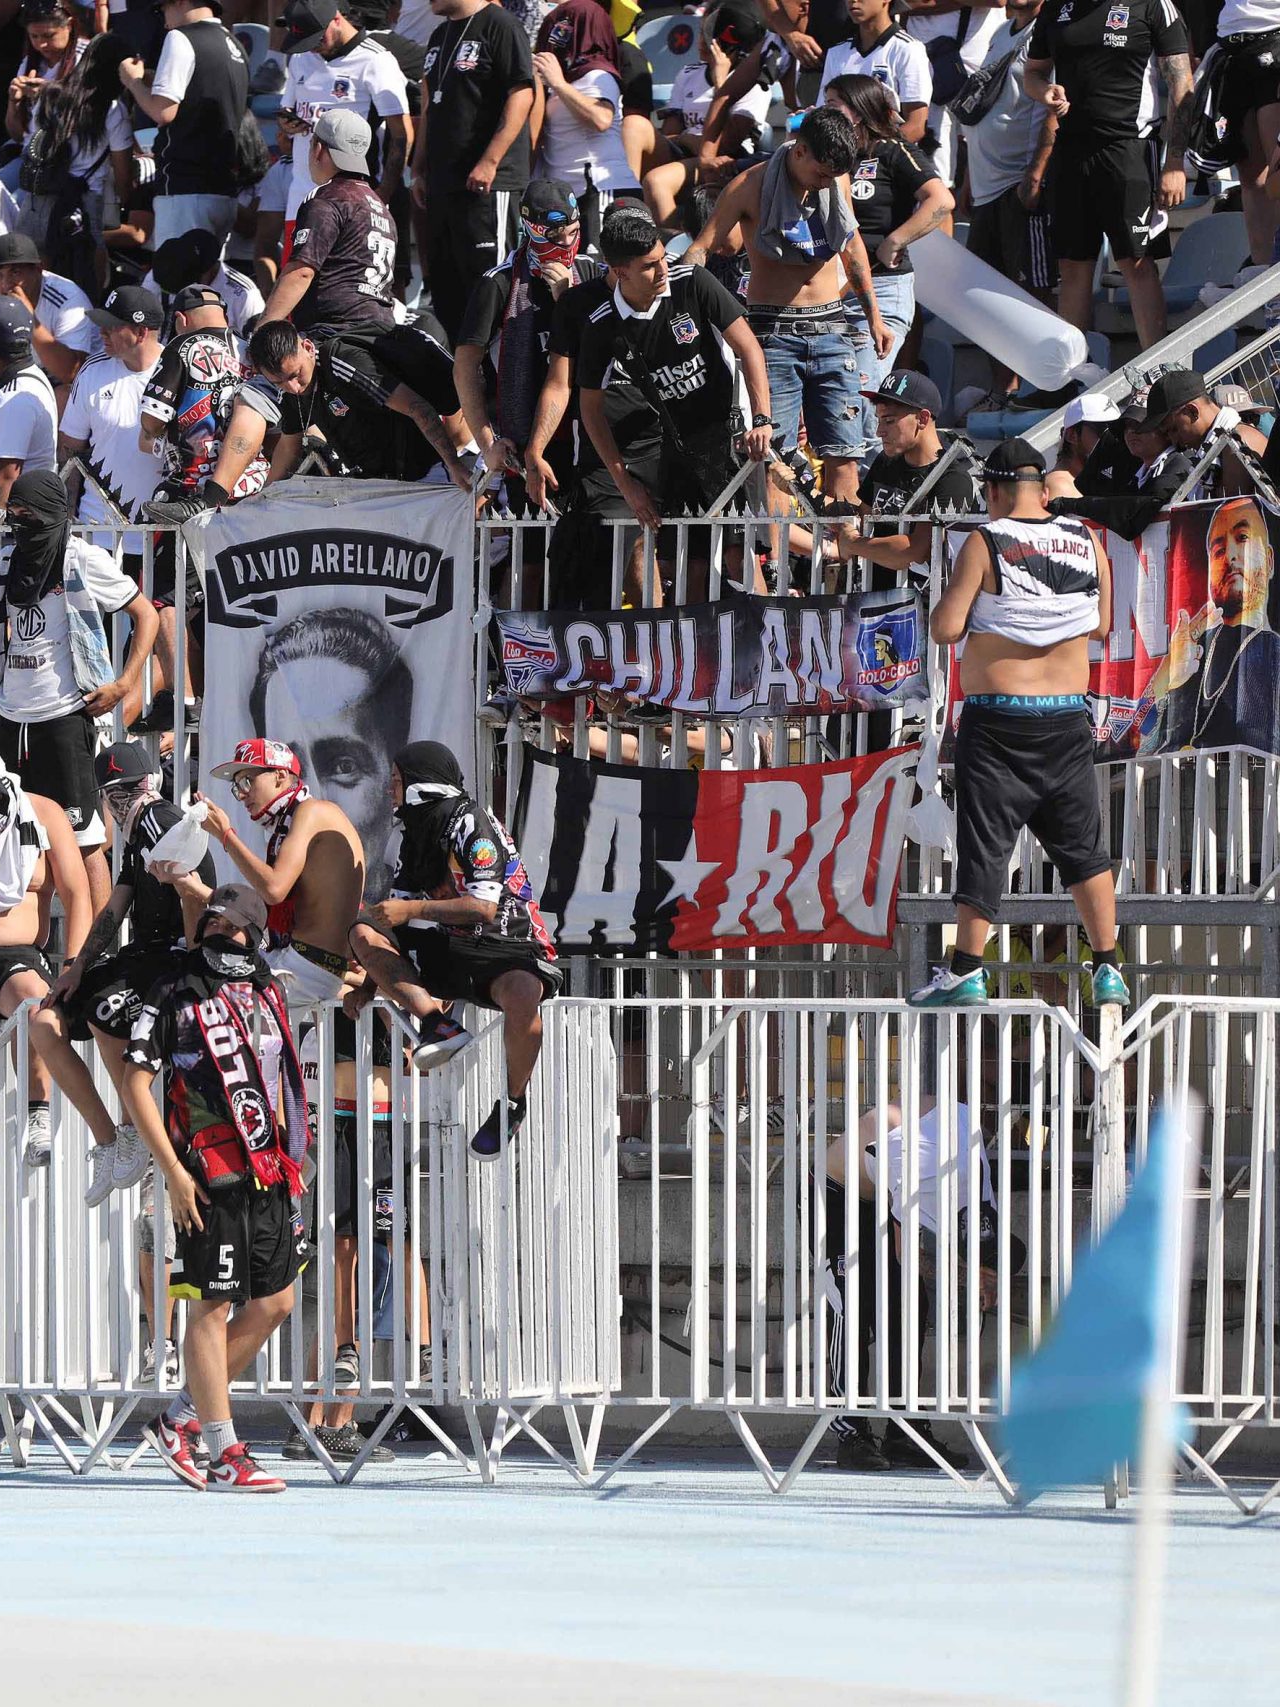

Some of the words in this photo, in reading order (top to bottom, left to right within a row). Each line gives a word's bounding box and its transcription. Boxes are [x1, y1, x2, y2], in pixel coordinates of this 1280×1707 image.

[1103, 33, 1128, 42] Pilsen
[851, 180, 875, 200] MG
[650, 353, 706, 387] Pilsen
[674, 367, 708, 400] Sur
[311, 543, 432, 583] ARELLANO
[17, 604, 46, 641] MG
[554, 607, 847, 714] CHILLAN
[996, 695, 1084, 707] PALMERS
[711, 749, 920, 937] RIO
[218, 1244, 234, 1280] 5
[209, 1281, 240, 1291] DIRECTV
